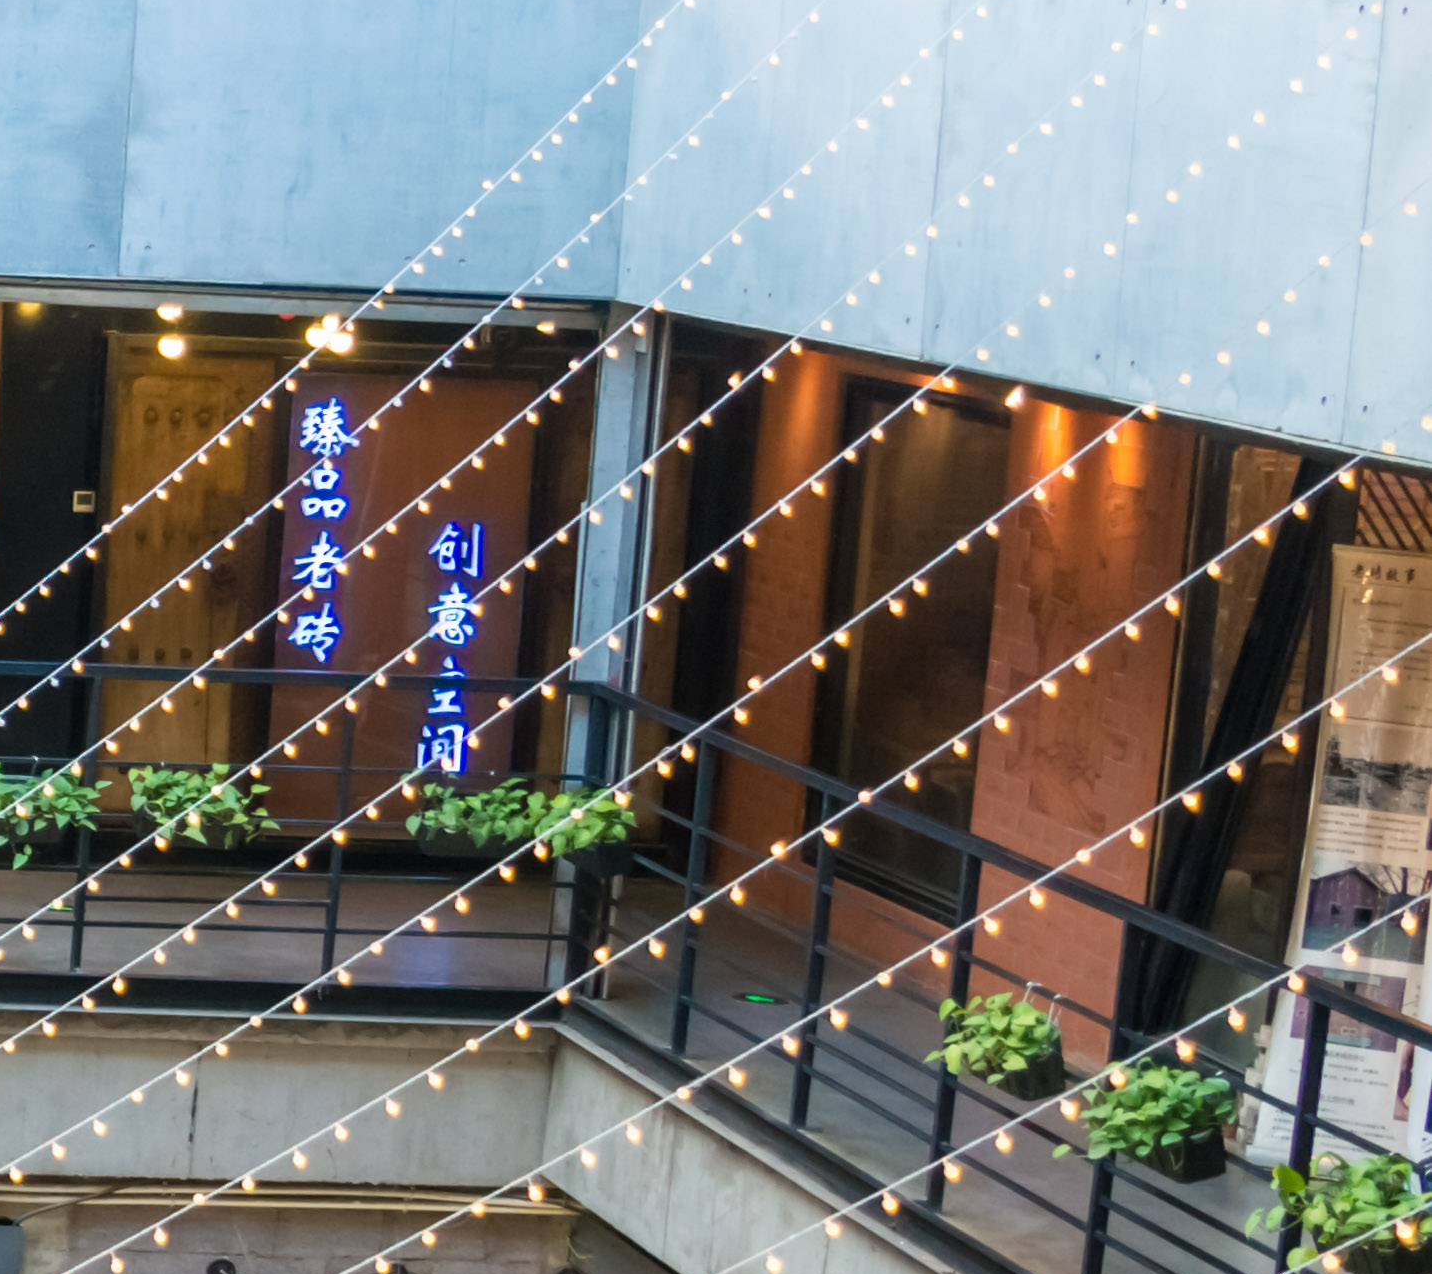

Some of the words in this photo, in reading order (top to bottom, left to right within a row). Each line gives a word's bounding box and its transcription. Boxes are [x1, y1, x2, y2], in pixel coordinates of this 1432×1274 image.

[288, 397, 358, 664] 臻品老砖
[416, 522, 484, 773] 创意空间
